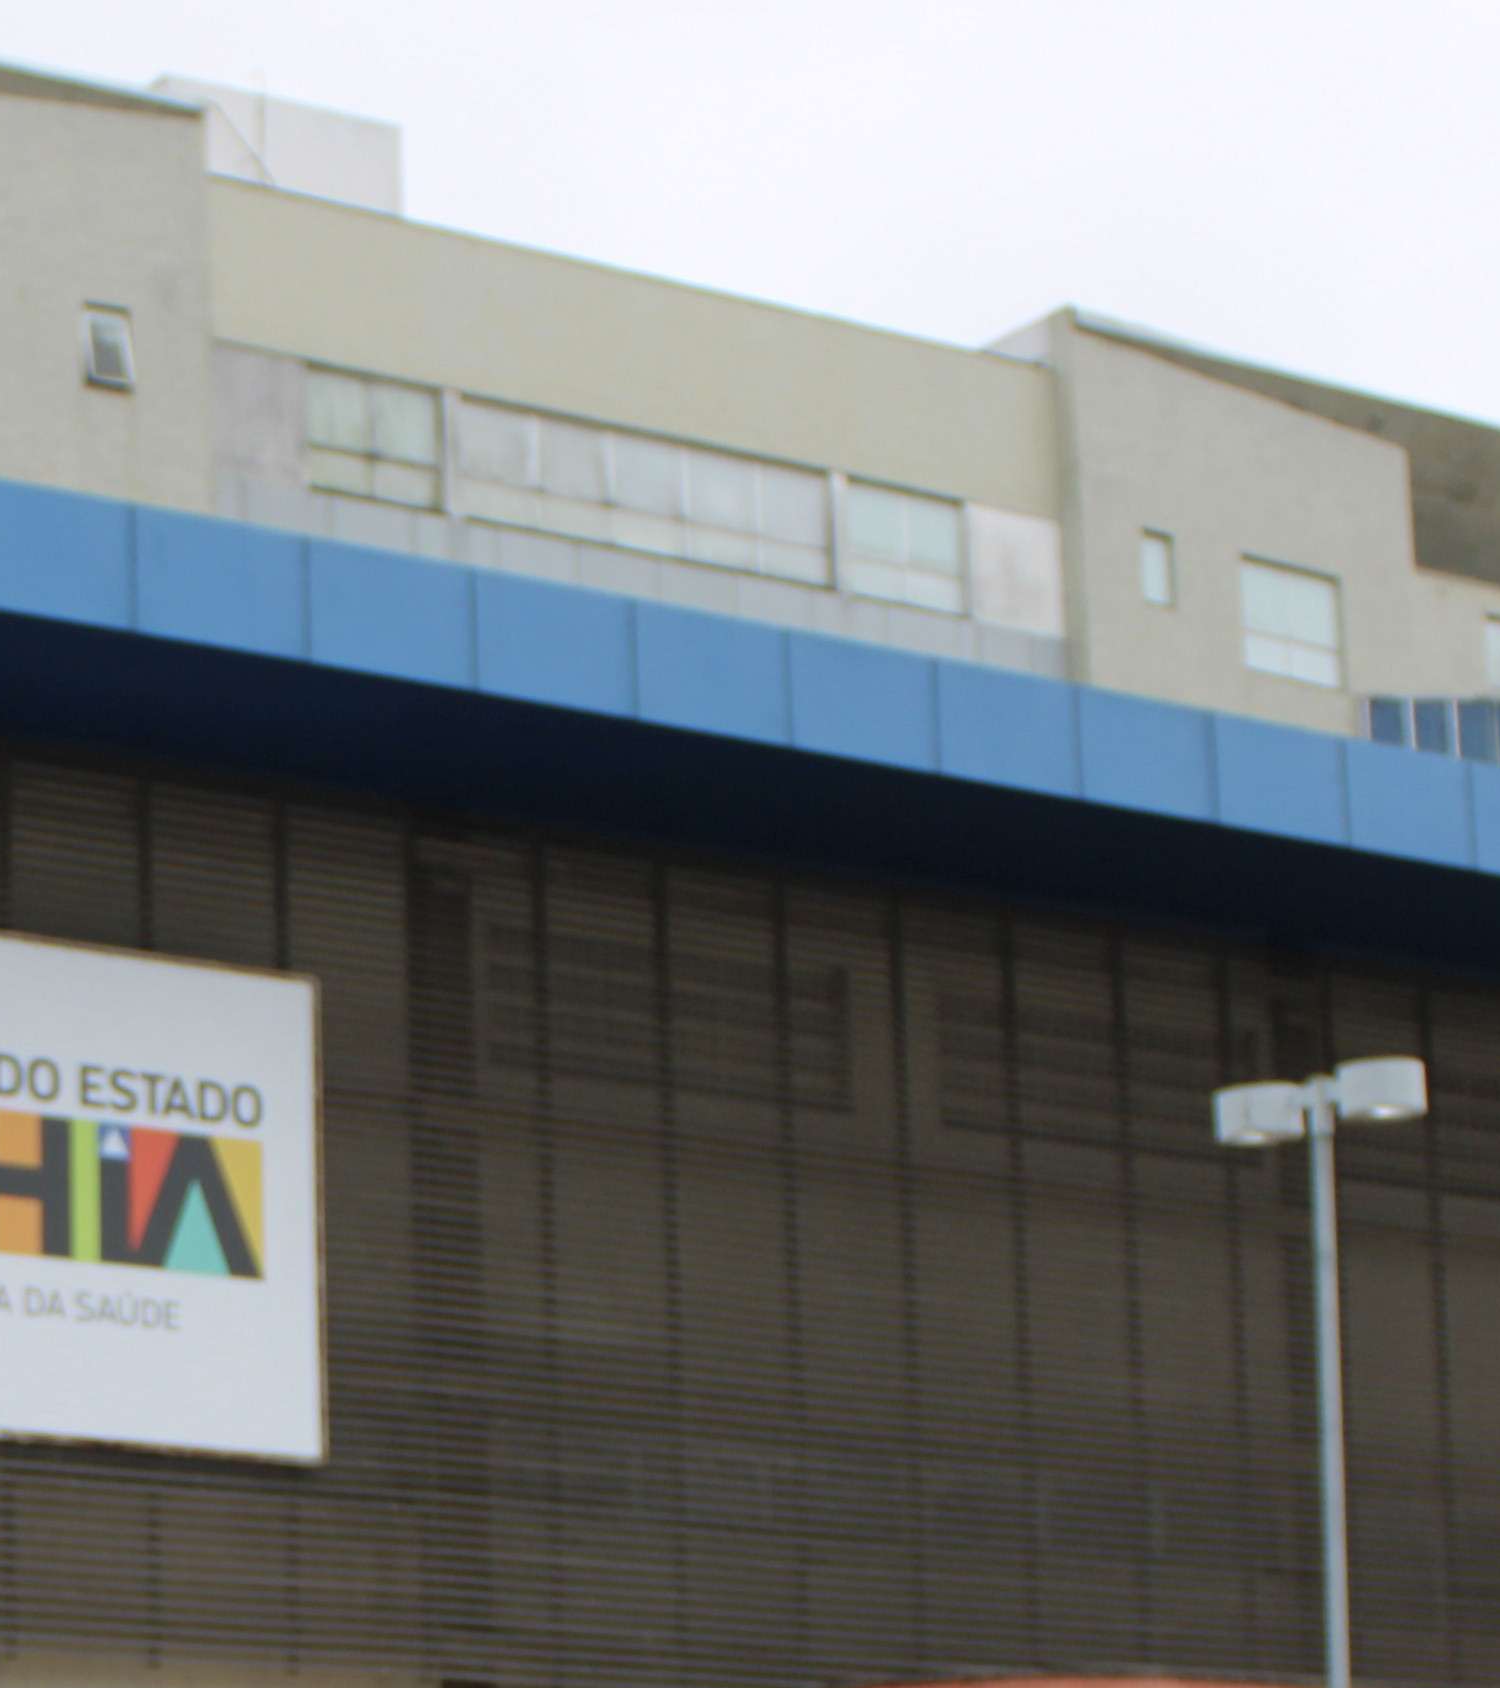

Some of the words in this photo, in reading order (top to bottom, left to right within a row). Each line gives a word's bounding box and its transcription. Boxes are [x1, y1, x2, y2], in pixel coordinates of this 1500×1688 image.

[79, 1064, 262, 1128] ESTADO
[24, 1284, 66, 1319] DA
[73, 1289, 183, 1331] SAÚDE
